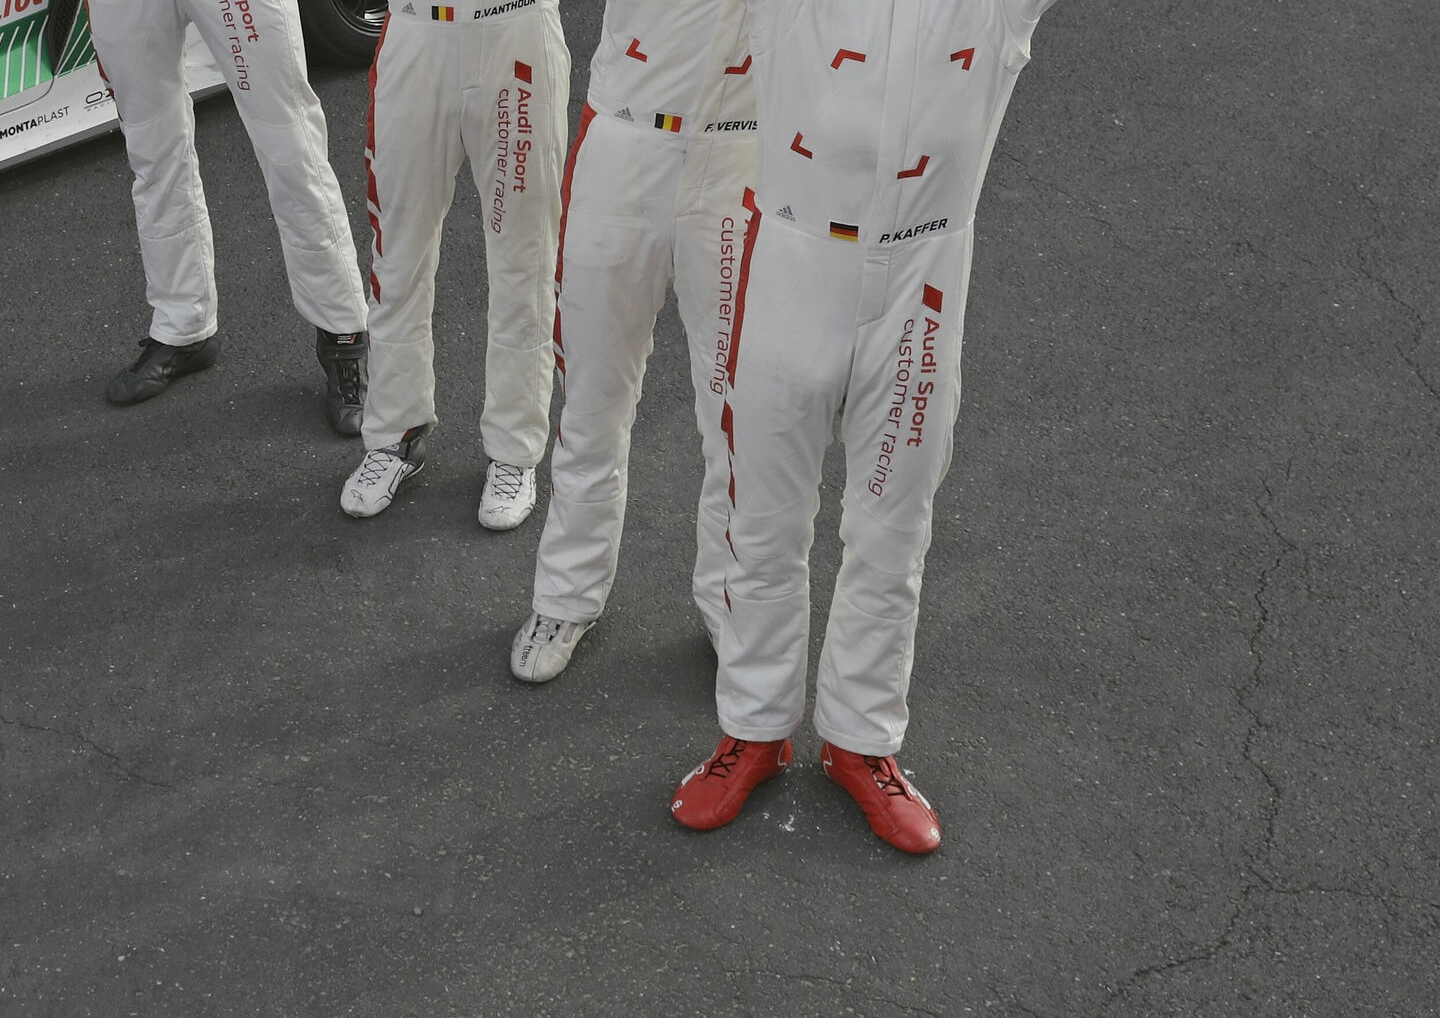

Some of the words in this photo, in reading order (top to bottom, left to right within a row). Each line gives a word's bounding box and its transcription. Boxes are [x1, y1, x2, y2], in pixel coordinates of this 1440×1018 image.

[228, 36, 251, 91] racing
[0, 106, 70, 140] MONTAPLAST
[497, 88, 512, 177] customer
[517, 87, 532, 133] Audi
[513, 140, 532, 194] Sport
[491, 179, 506, 234] racing
[719, 217, 735, 326] customer
[710, 331, 729, 395] racing
[887, 318, 915, 429] customer
[920, 317, 940, 374] Audi
[907, 381, 934, 447] Sport
[868, 432, 897, 497] racing
